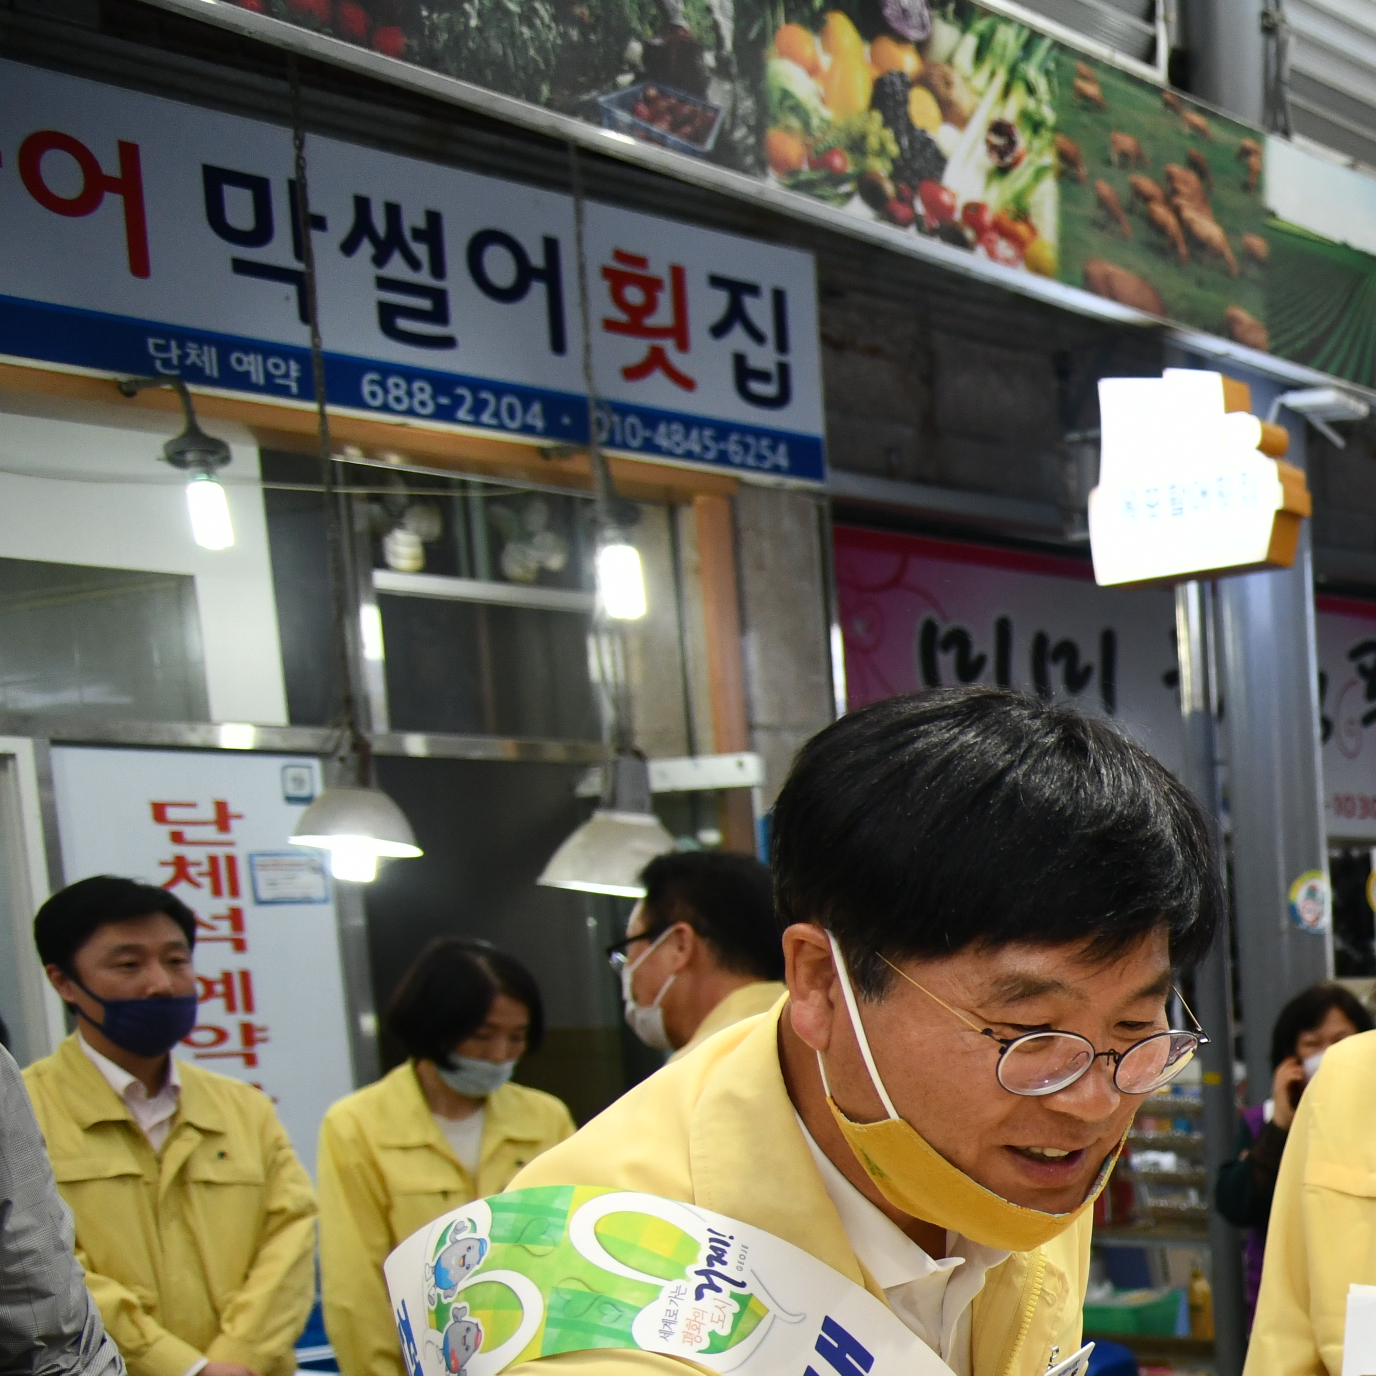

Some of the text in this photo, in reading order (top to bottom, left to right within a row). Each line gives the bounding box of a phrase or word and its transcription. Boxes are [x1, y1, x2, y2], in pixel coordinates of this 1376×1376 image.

[0, 129, 151, 280] 어
[146, 336, 220, 380] 단체
[229, 350, 302, 394] 예약
[360, 371, 546, 433] 688-2204
[736, 1243, 749, 1272] GEOJE
[658, 1284, 688, 1342] 세계로 가는
[682, 1307, 709, 1346] 평화의
[710, 1297, 733, 1329] 도시
